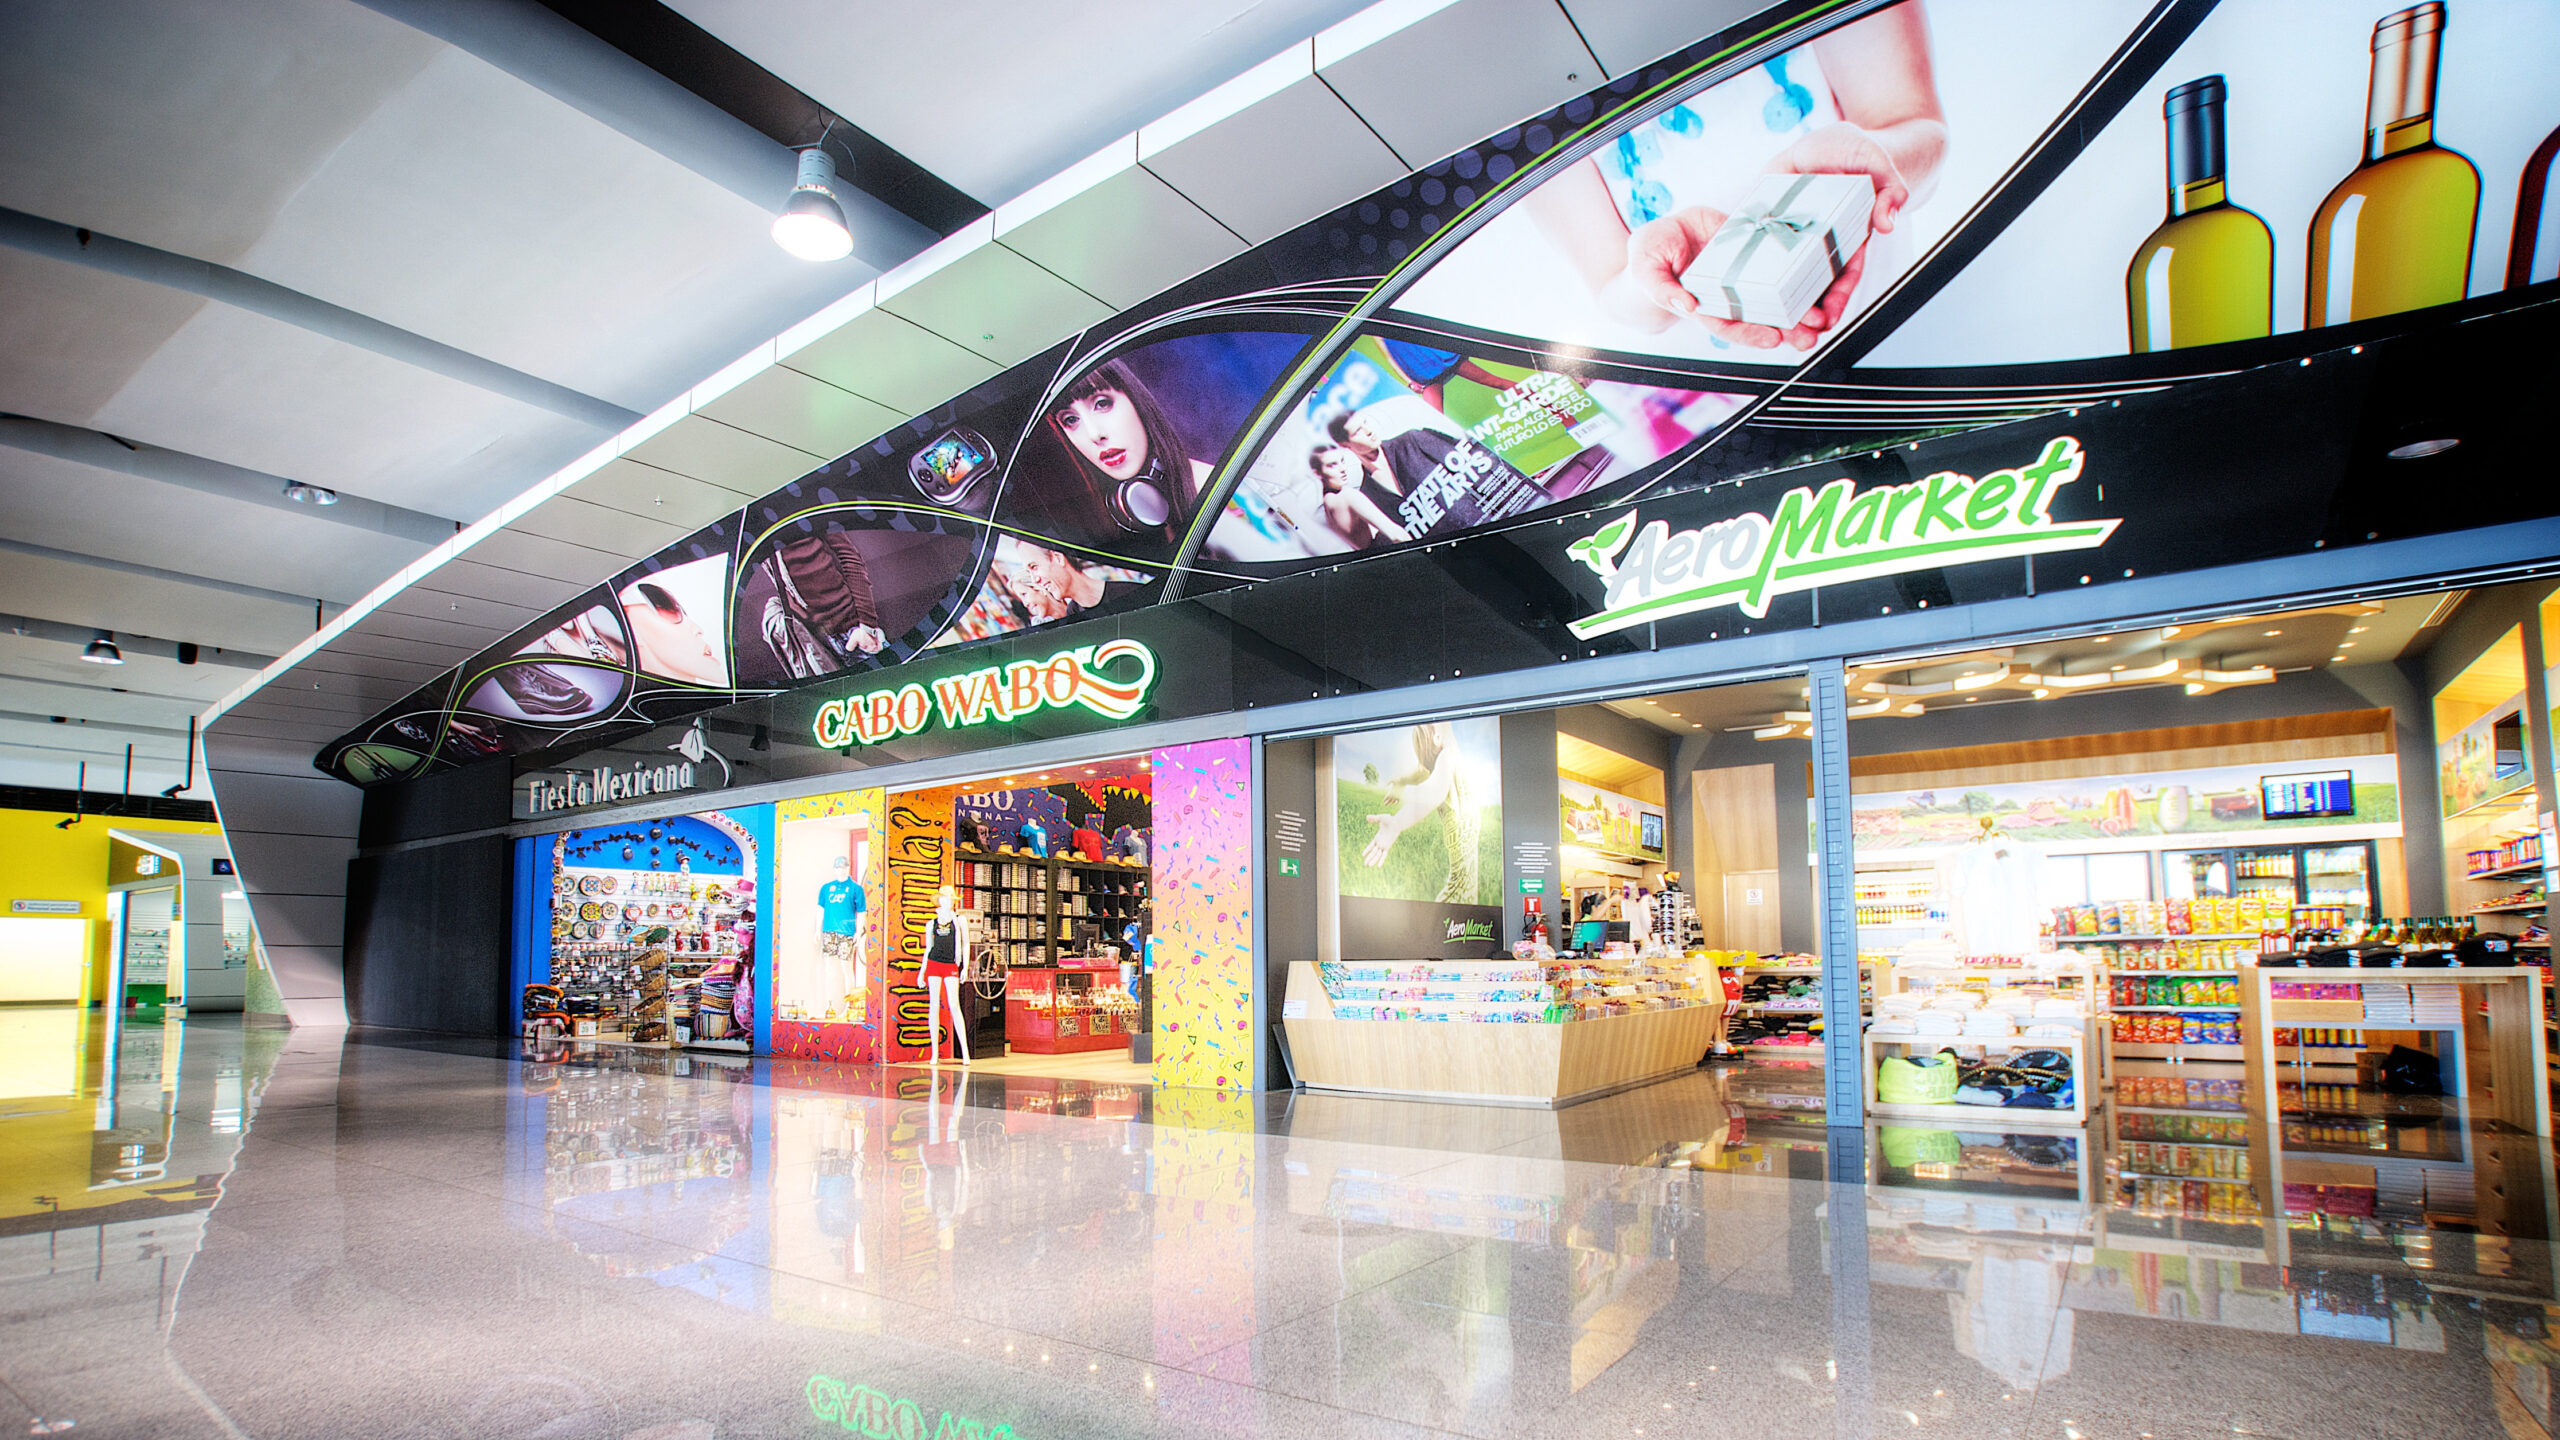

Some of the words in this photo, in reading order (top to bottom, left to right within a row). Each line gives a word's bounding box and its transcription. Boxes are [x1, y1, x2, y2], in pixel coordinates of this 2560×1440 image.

[1493, 429, 1534, 455] FUTURO
[1533, 419, 1549, 435] LO
[1549, 414, 1563, 428] ES
[1560, 398, 1592, 420] TODO
[1495, 422, 1522, 443] PARA
[1523, 397, 1571, 428] ALGUNOS
[1569, 391, 1585, 403] EL
[1398, 463, 1451, 523] STATE
[1444, 440, 1474, 473] OF
[1404, 498, 1446, 540] THE
[1441, 451, 1493, 510] ARTS
[1600, 436, 2085, 620] AeroMarket
[814, 686, 930, 746] CABO
[933, 654, 1084, 727] WABO
[529, 769, 593, 813] Fiesta
[593, 761, 695, 803] Mexicana
[1446, 919, 1495, 943] AeroMarket
